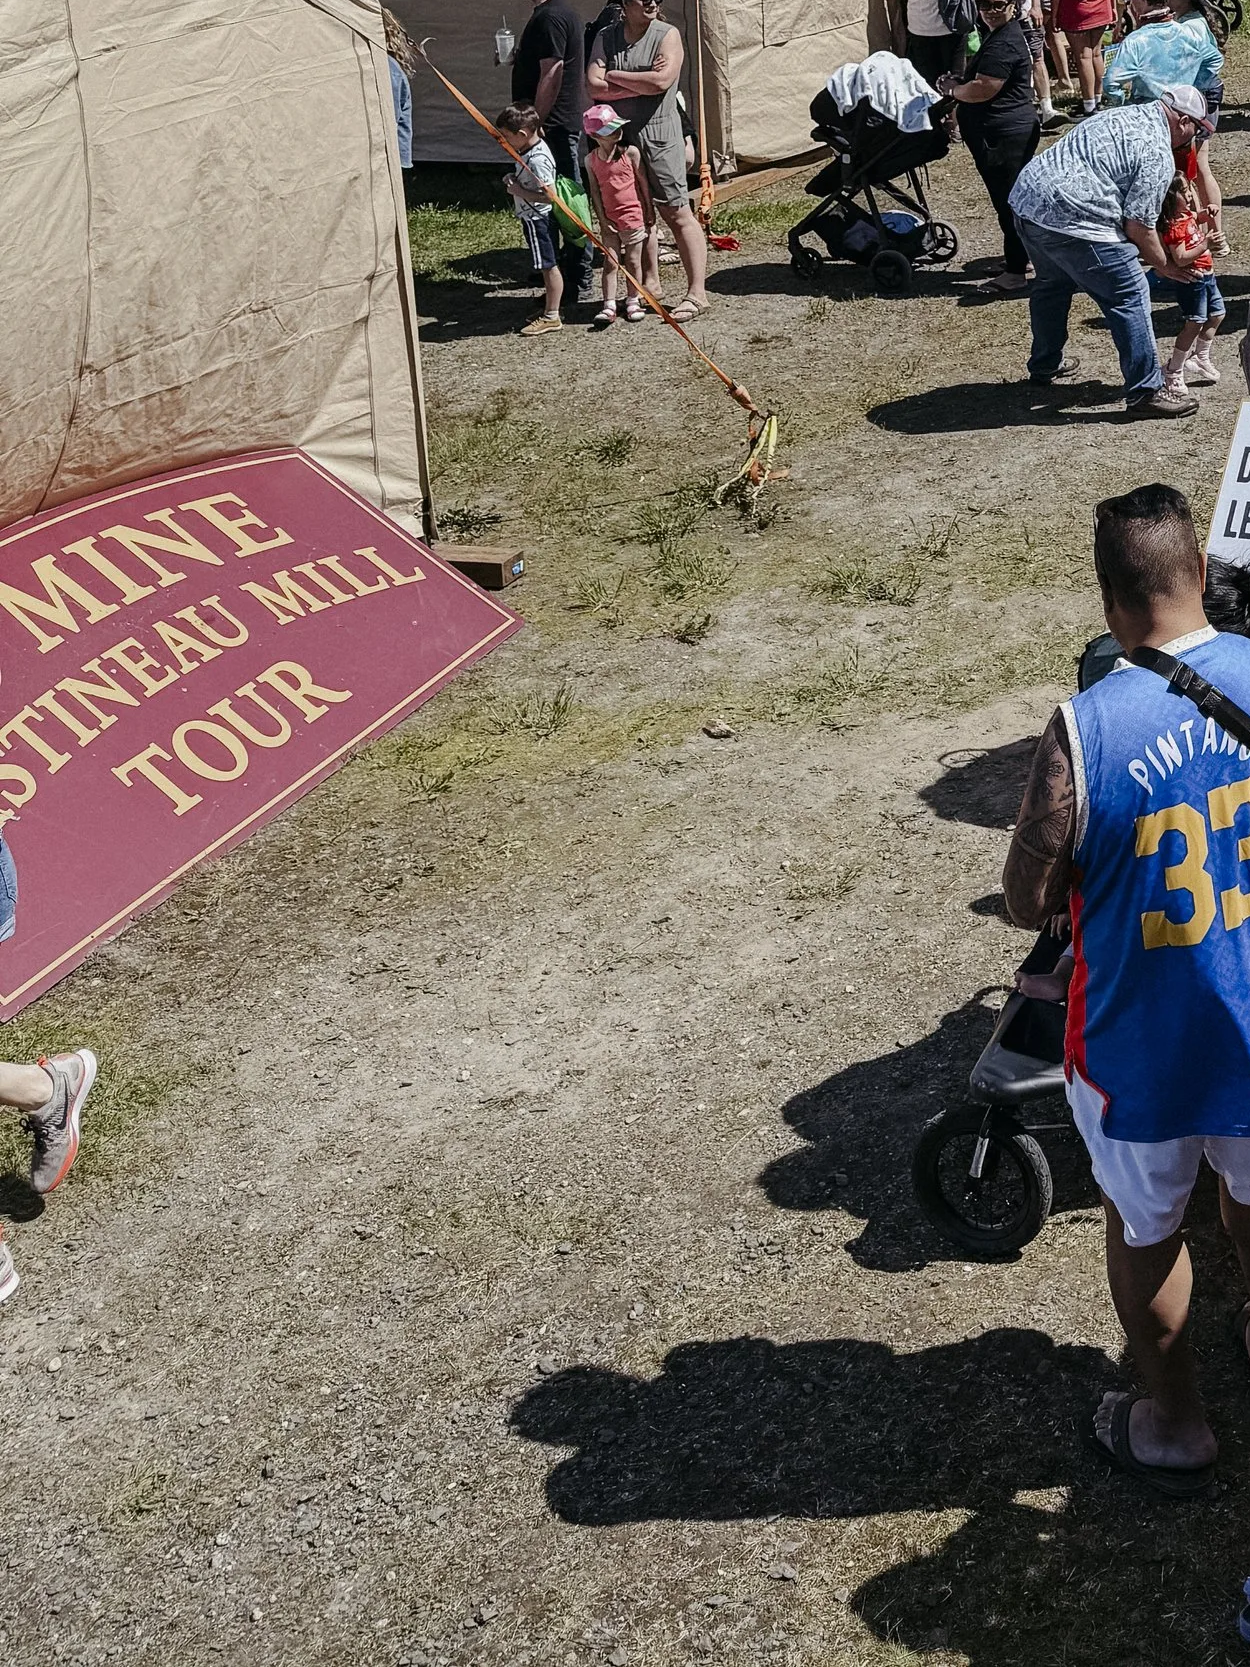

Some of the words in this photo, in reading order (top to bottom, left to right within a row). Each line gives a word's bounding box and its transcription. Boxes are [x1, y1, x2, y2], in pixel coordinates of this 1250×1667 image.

[0, 492, 295, 654] MINE
[239, 546, 427, 626] MILL
[111, 660, 353, 817] TOUR
